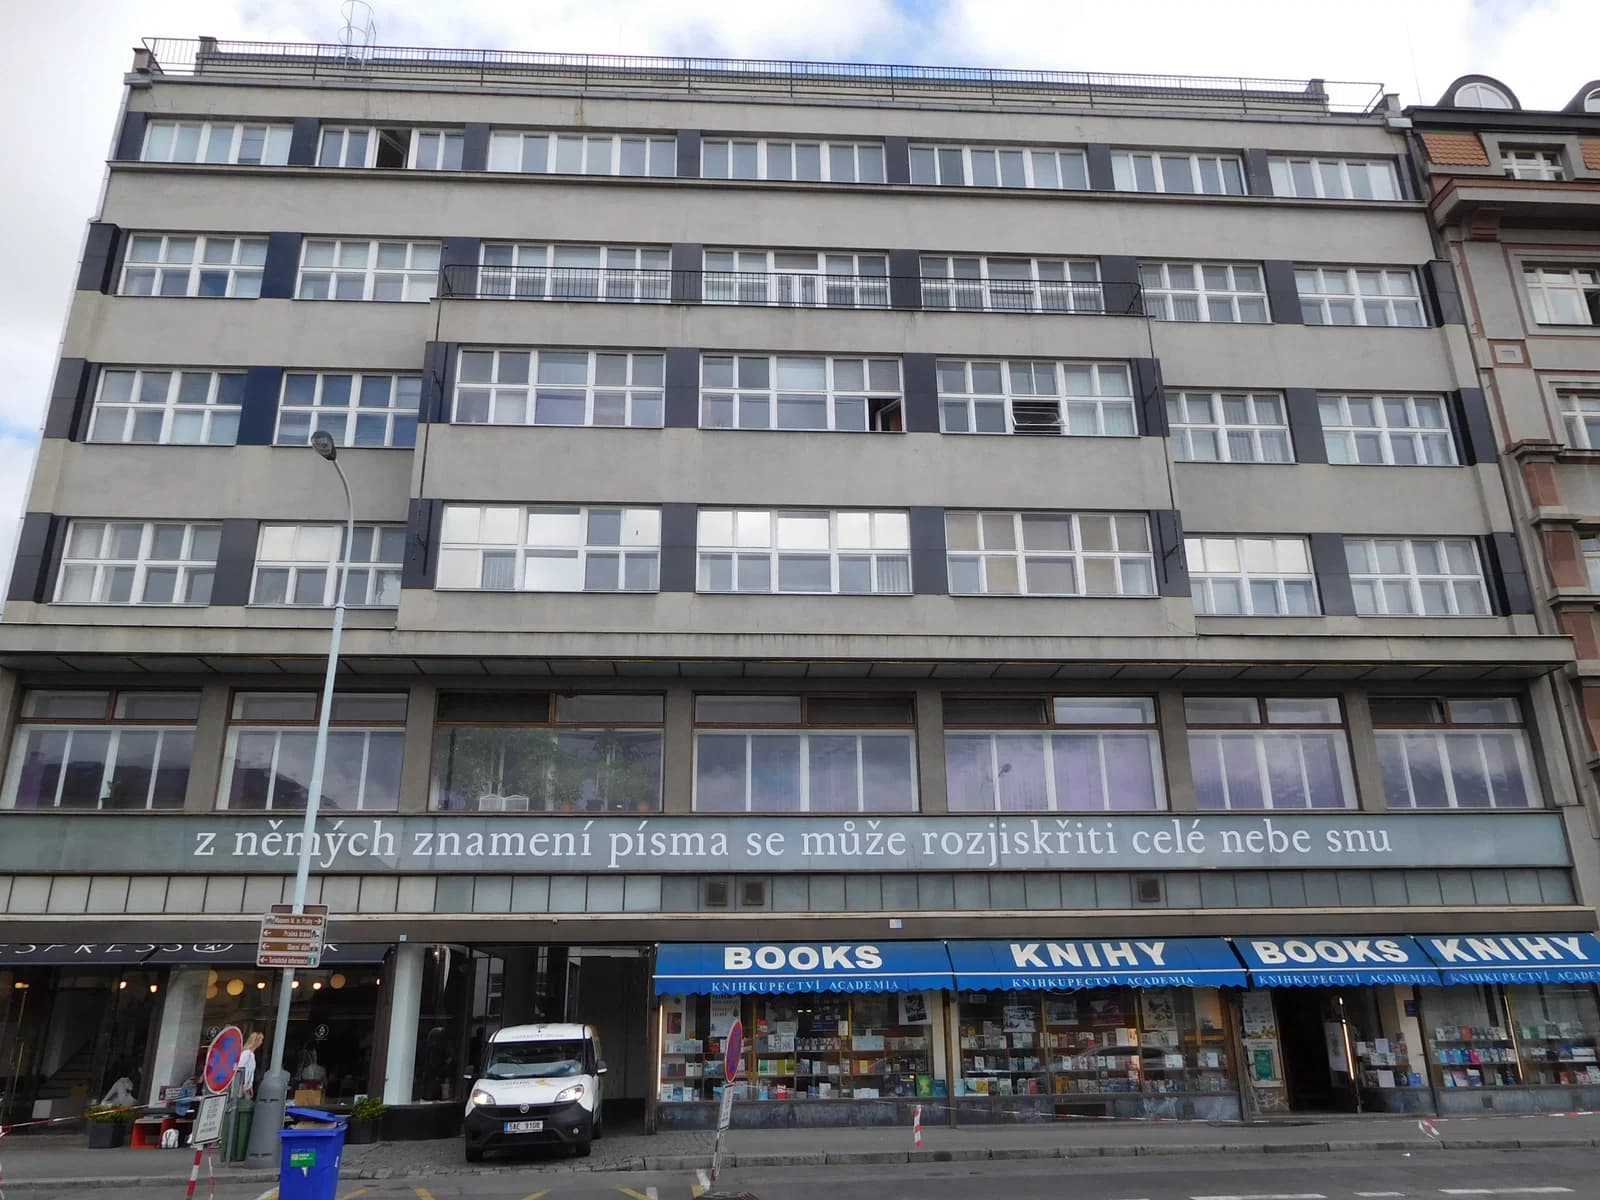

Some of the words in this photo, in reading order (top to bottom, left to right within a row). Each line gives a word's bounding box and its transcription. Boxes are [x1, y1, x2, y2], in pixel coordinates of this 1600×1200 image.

[193, 832, 217, 856] z
[232, 820, 396, 869] němých
[412, 820, 594, 857] znamení
[607, 820, 729, 868] písma
[746, 832, 785, 856] se
[800, 820, 906, 856] může
[921, 819, 1118, 867] rozjiskřiti
[1132, 819, 1206, 854] celé
[1220, 818, 1312, 853] nebe
[1326, 829, 1393, 853] snu
[724, 945, 883, 970] BOOKS
[1009, 941, 1166, 968] KNIHY
[1251, 939, 1409, 964] BOOKS
[1431, 936, 1589, 962] KNIHY
[711, 979, 820, 992] KNIHKUPECTVÍ
[830, 980, 899, 991] ACADEMIA
[1012, 975, 1118, 988] KNIHKUPECTVÍ
[1127, 976, 1194, 986] ACADEMIA
[1259, 972, 1361, 985] KNIHKUPECTVÍ
[1369, 973, 1435, 983] ACADEMIA
[1450, 970, 1549, 983] KNIHKUPECTVÍ
